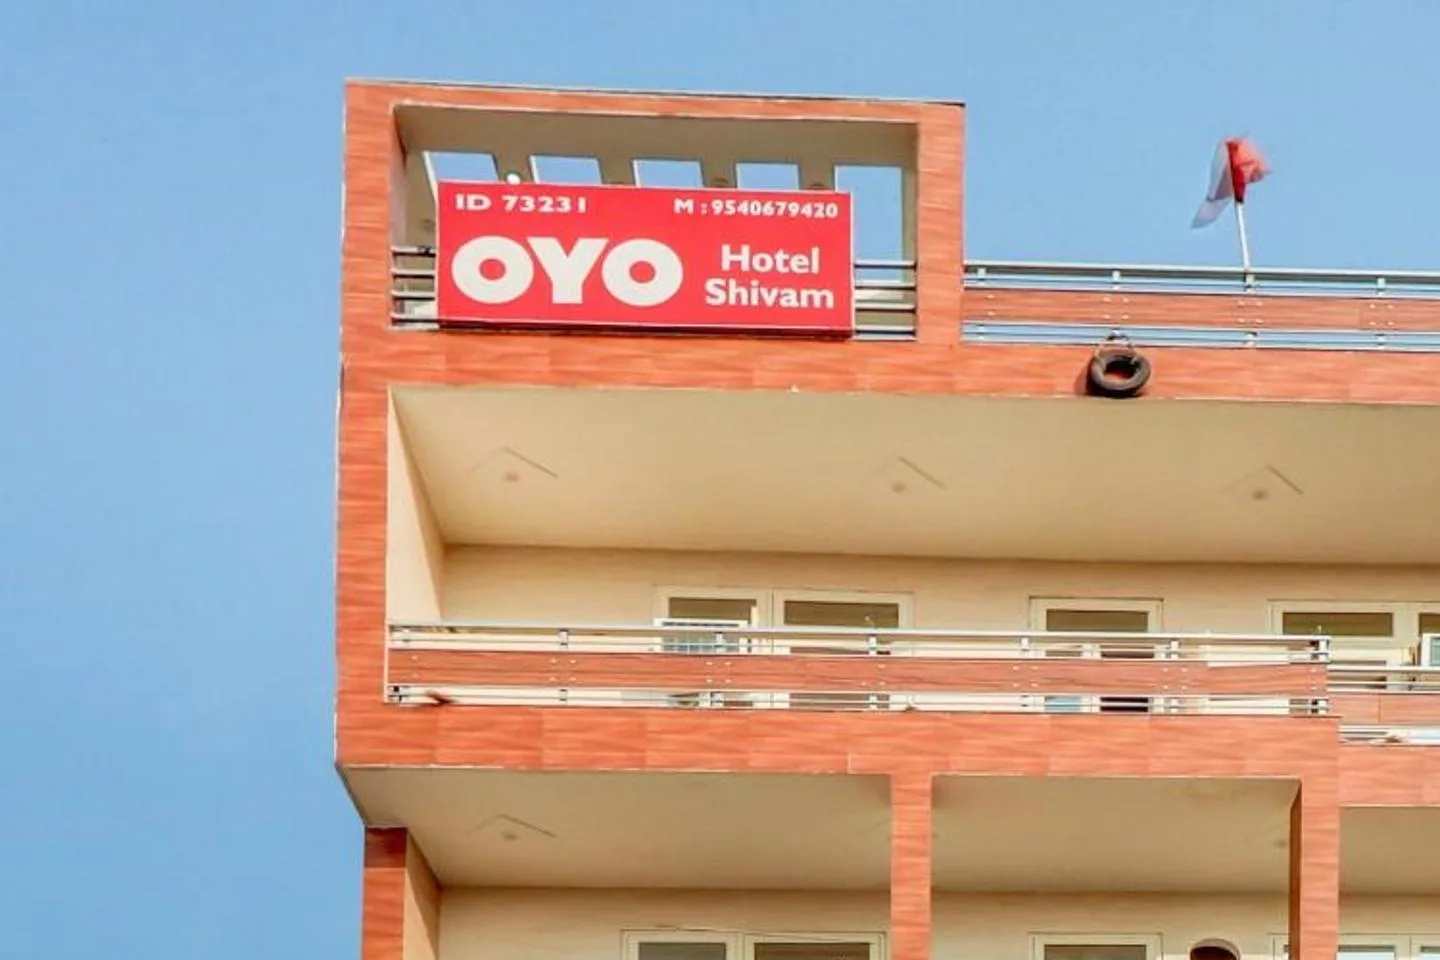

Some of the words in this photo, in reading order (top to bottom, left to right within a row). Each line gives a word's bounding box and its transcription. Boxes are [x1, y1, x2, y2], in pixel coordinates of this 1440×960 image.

[455, 193, 492, 211] ID
[502, 194, 587, 213] 73231
[451, 235, 684, 307] OYO
[721, 244, 820, 275] Hotel
[704, 278, 835, 309] Shivam
